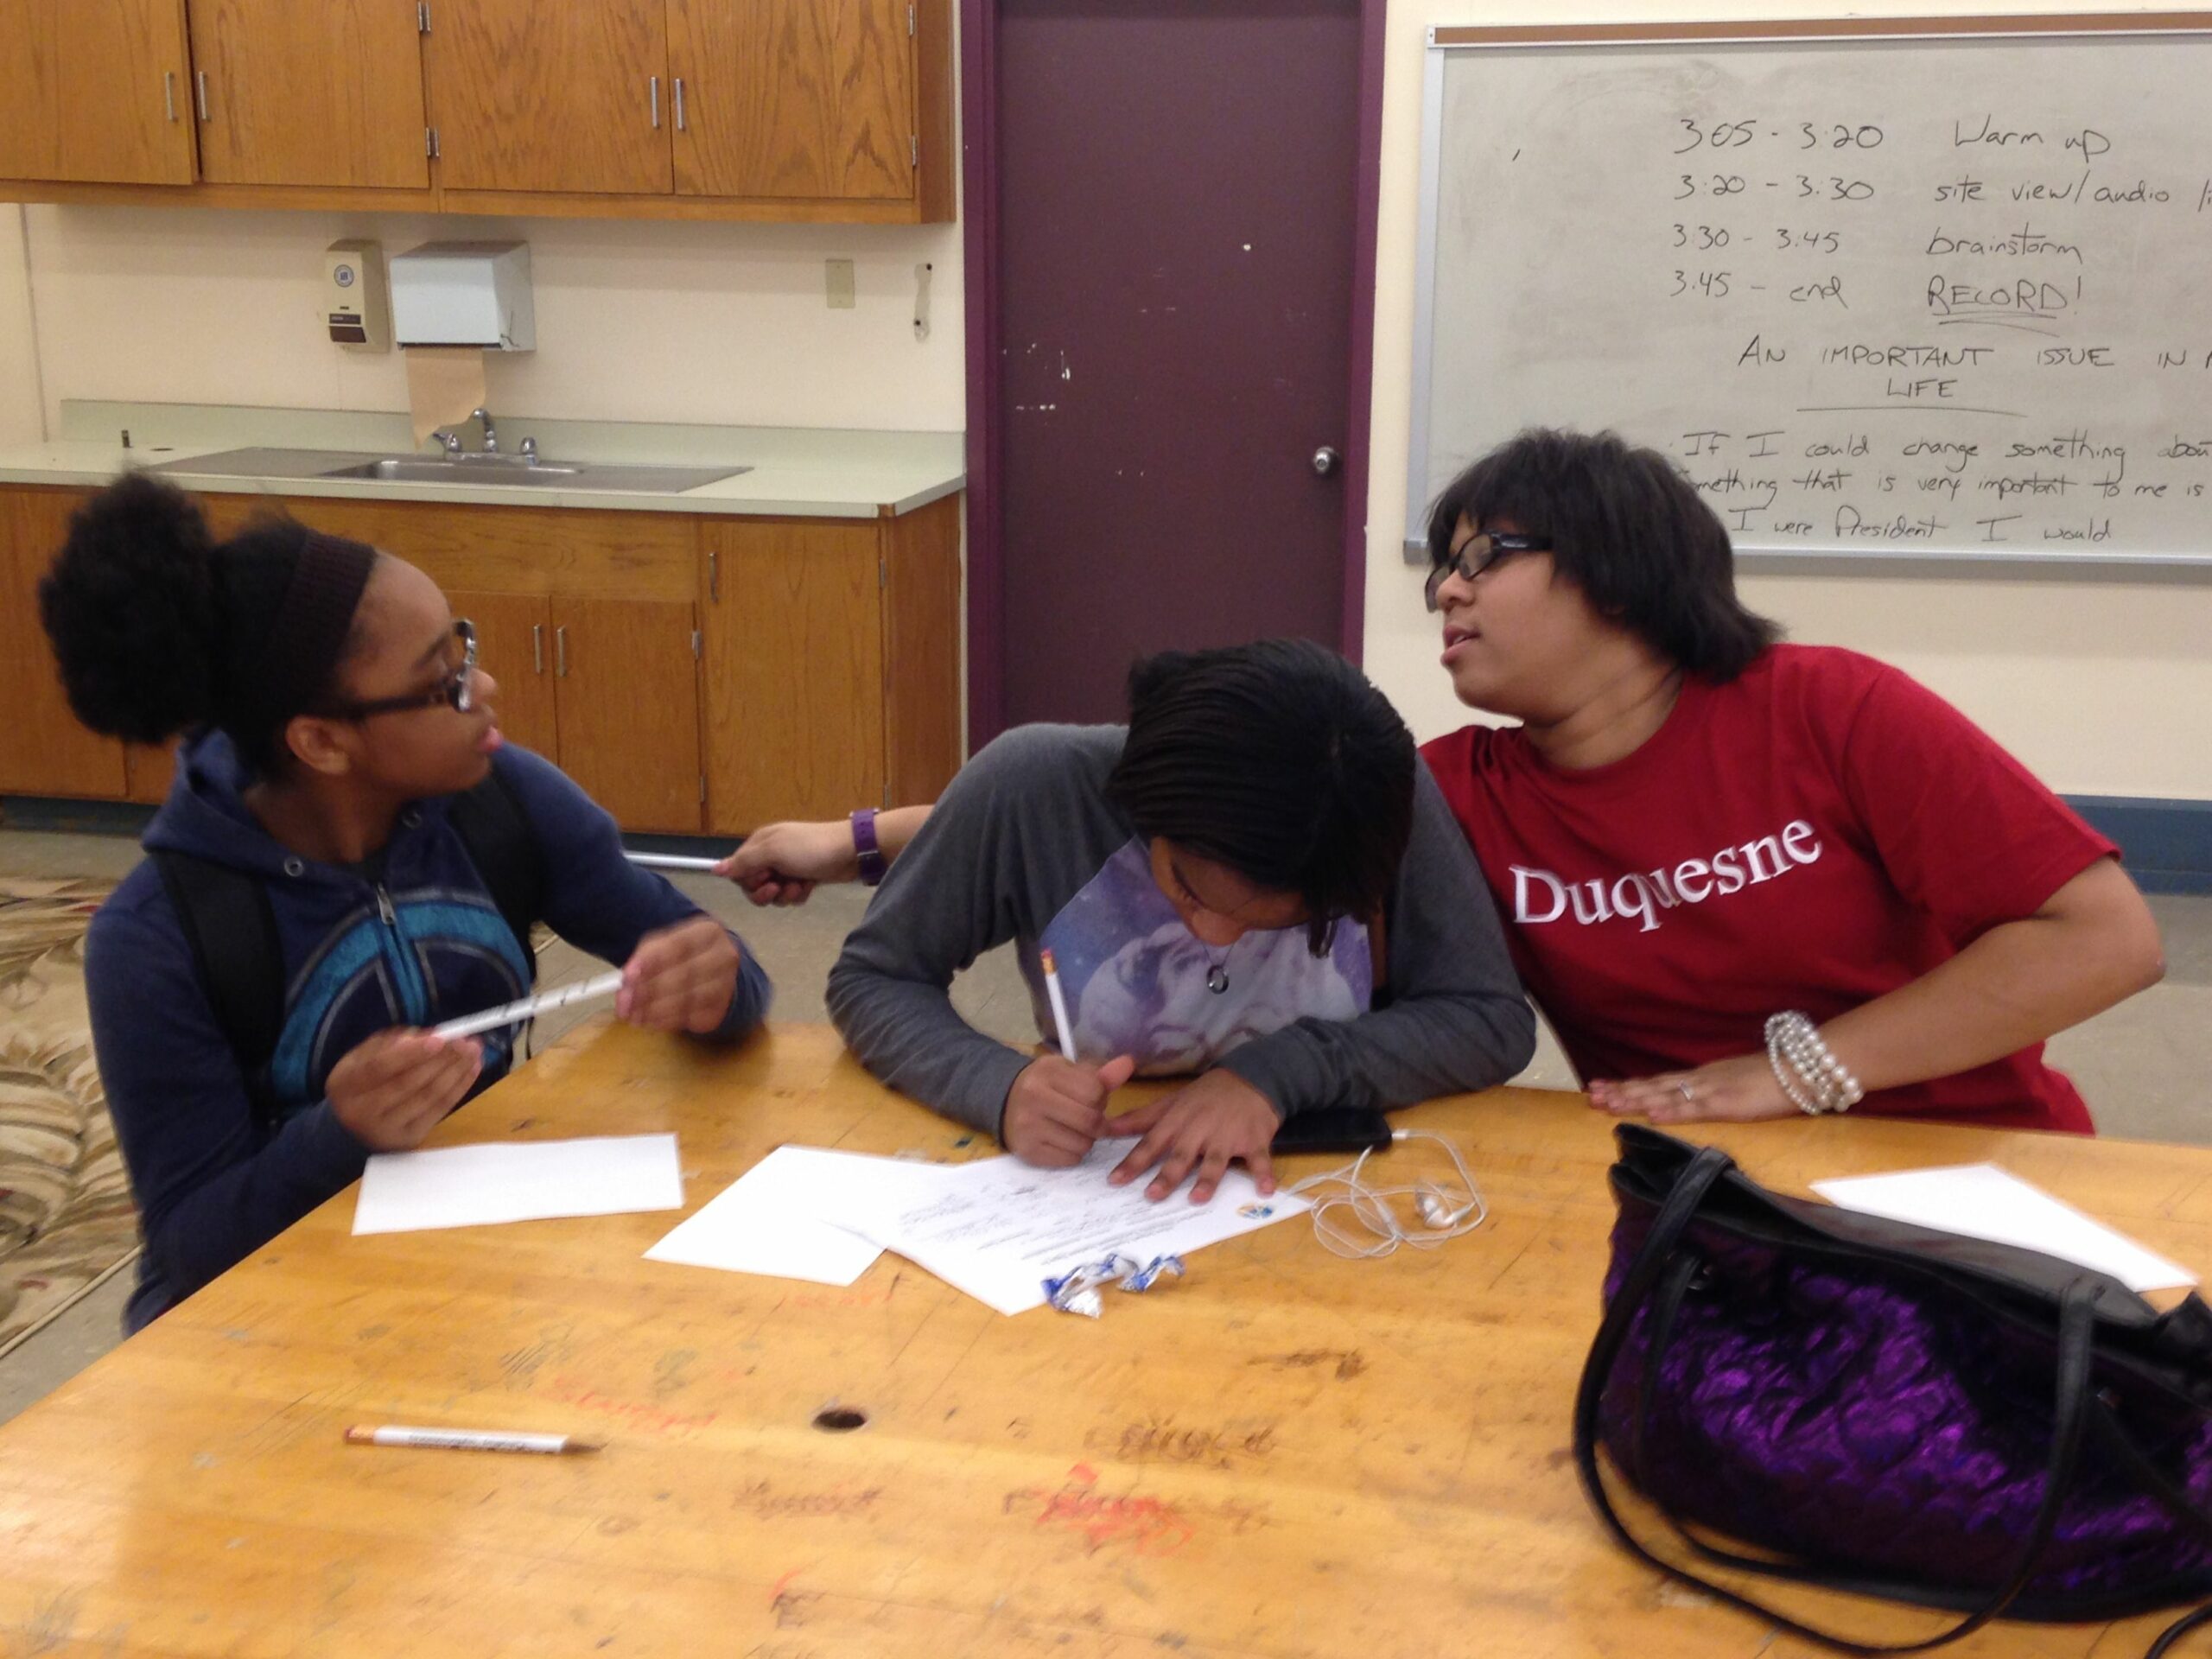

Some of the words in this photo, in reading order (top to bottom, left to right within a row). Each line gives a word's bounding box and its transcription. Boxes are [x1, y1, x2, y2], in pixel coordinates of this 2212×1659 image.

[1955, 113, 2044, 147] Warm
[2065, 129, 2111, 163] up
[1935, 175, 1986, 203] site
[1925, 221, 2083, 264] brainstorm
[1789, 276, 1849, 310] end
[1927, 275, 2082, 316] RECORD!
[1822, 345, 1995, 368] IMPORTANT
[2037, 347, 2115, 367] ISSUE
[2158, 350, 2187, 369] IN
[1886, 378, 1959, 397] LIFE
[1746, 430, 1786, 458] I
[1805, 434, 1870, 458] could
[1903, 437, 1980, 474] change
[2005, 429, 2126, 483] something
[1792, 469, 1853, 493] that
[1878, 475, 1897, 492] is
[1917, 476, 1962, 502] very
[1978, 472, 2079, 500] important
[2092, 471, 2120, 499] to
[2134, 485, 2168, 499] me
[2187, 484, 2204, 498] is
[1728, 506, 1767, 531] I
[1774, 520, 1814, 537] were
[1834, 505, 1949, 539] President
[1976, 514, 2023, 543] I
[2044, 518, 2112, 542] would
[1508, 818, 1823, 933] Duquesne
